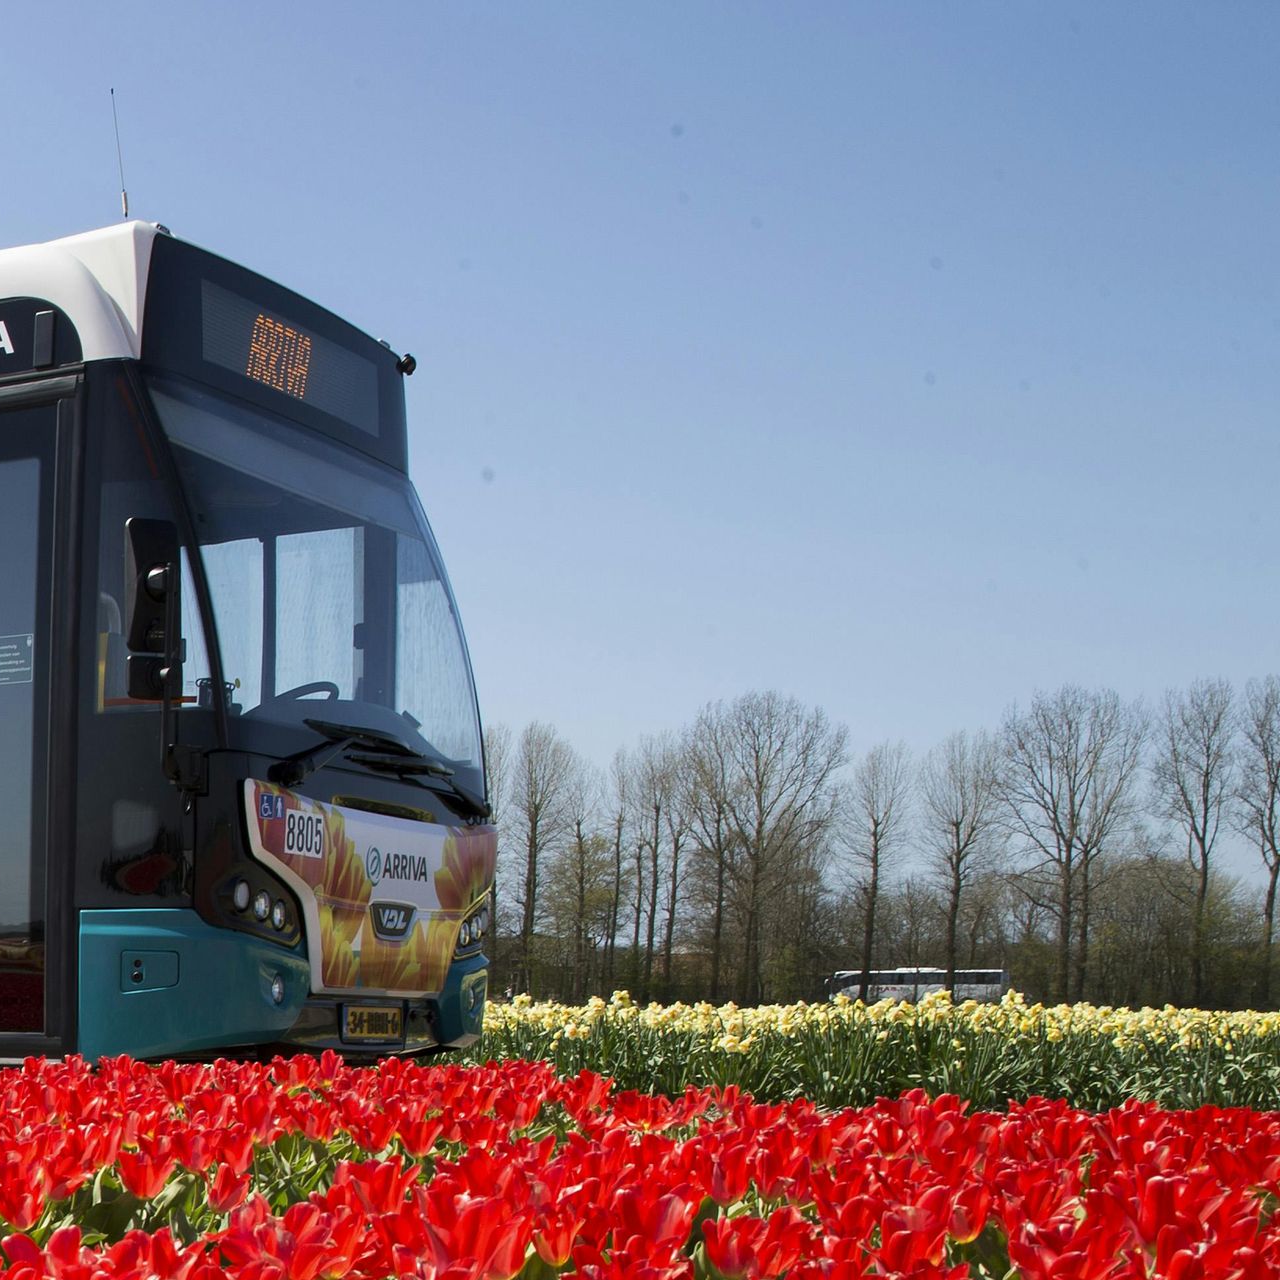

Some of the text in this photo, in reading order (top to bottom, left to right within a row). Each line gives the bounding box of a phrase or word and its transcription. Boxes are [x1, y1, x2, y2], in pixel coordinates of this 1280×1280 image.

[246, 314, 312, 399] ARRIVA
[286, 813, 323, 855] 8805
[382, 853, 428, 883] ARRIVA
[378, 907, 407, 930] VDL
